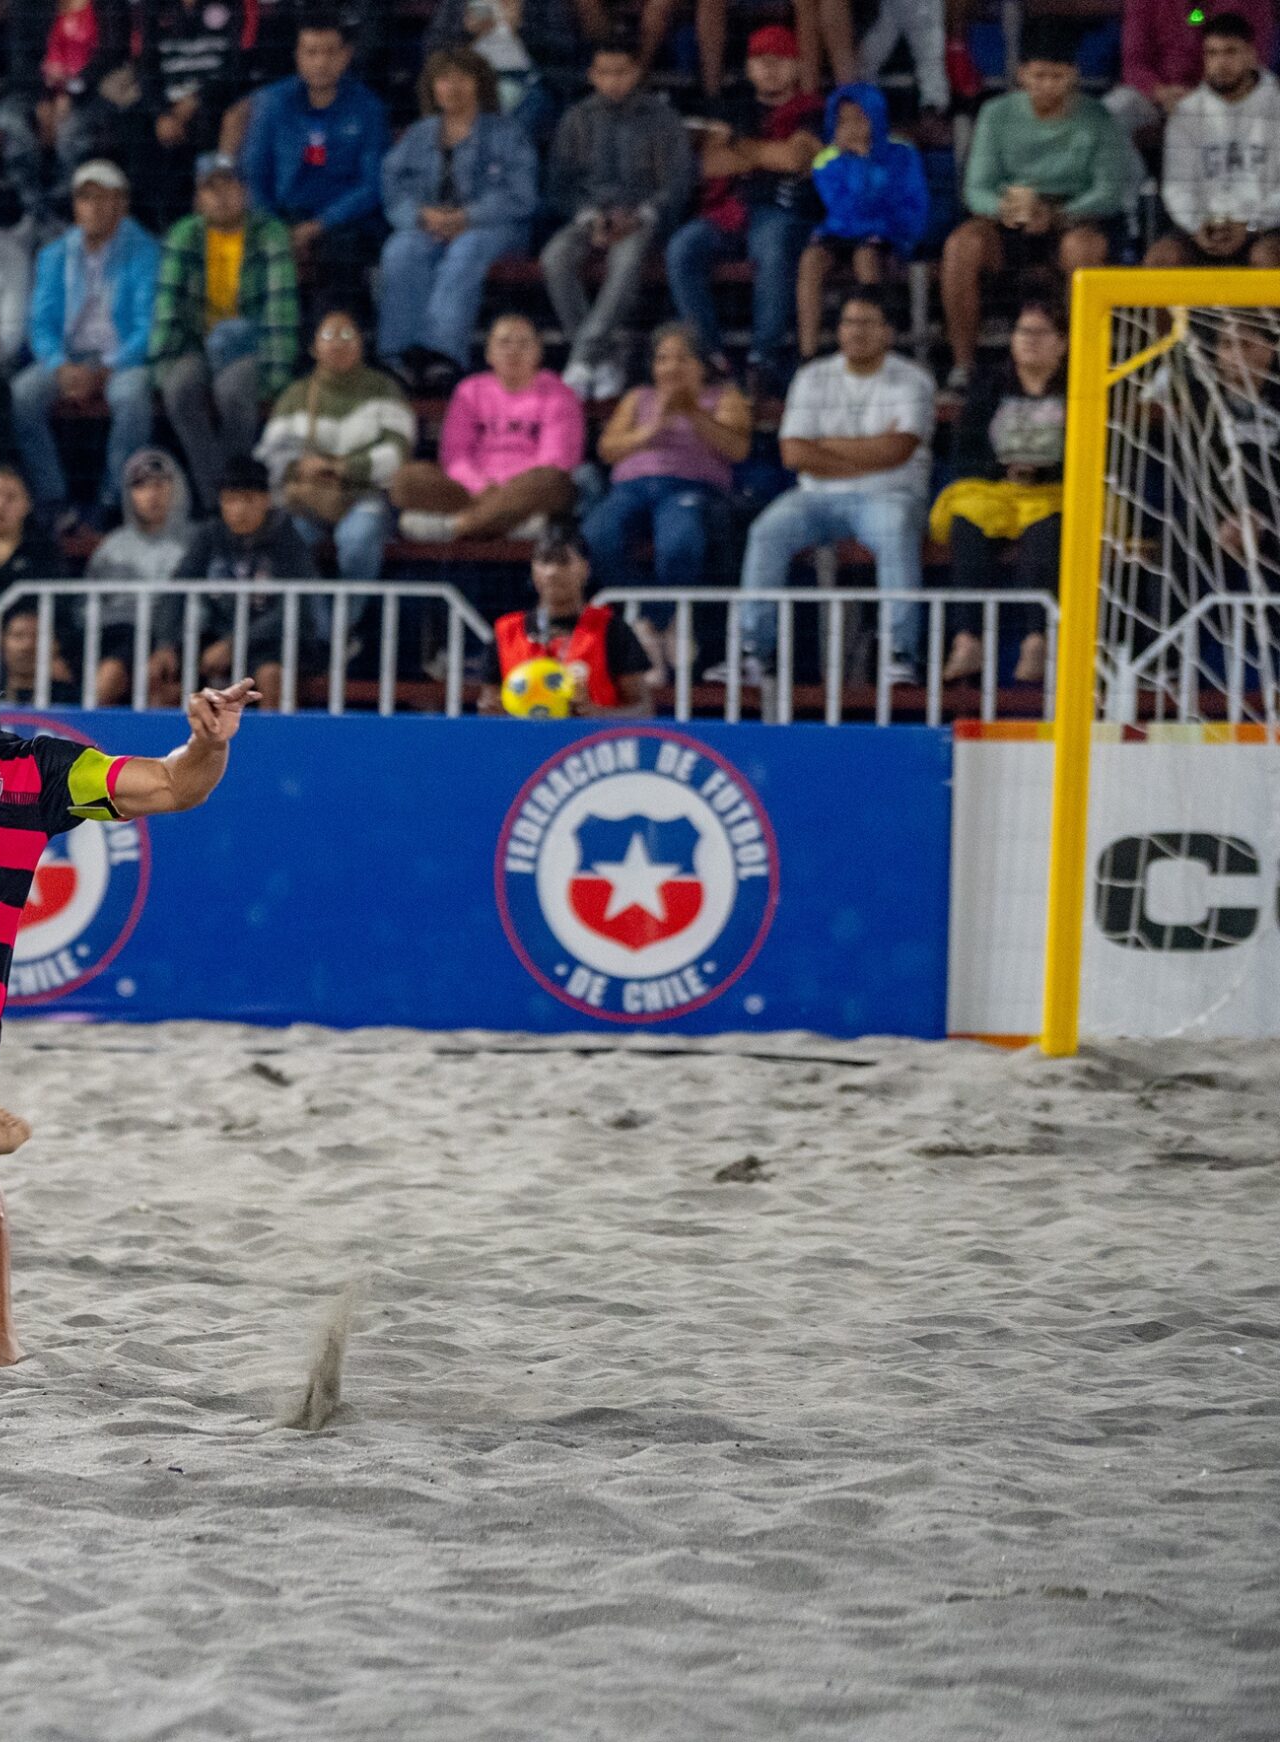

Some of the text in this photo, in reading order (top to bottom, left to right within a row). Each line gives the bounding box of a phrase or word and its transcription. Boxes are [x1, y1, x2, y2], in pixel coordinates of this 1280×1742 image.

[655, 740, 699, 783] DE
[700, 768, 769, 881] FUTBOL
[565, 964, 711, 1013] DE CHILE
